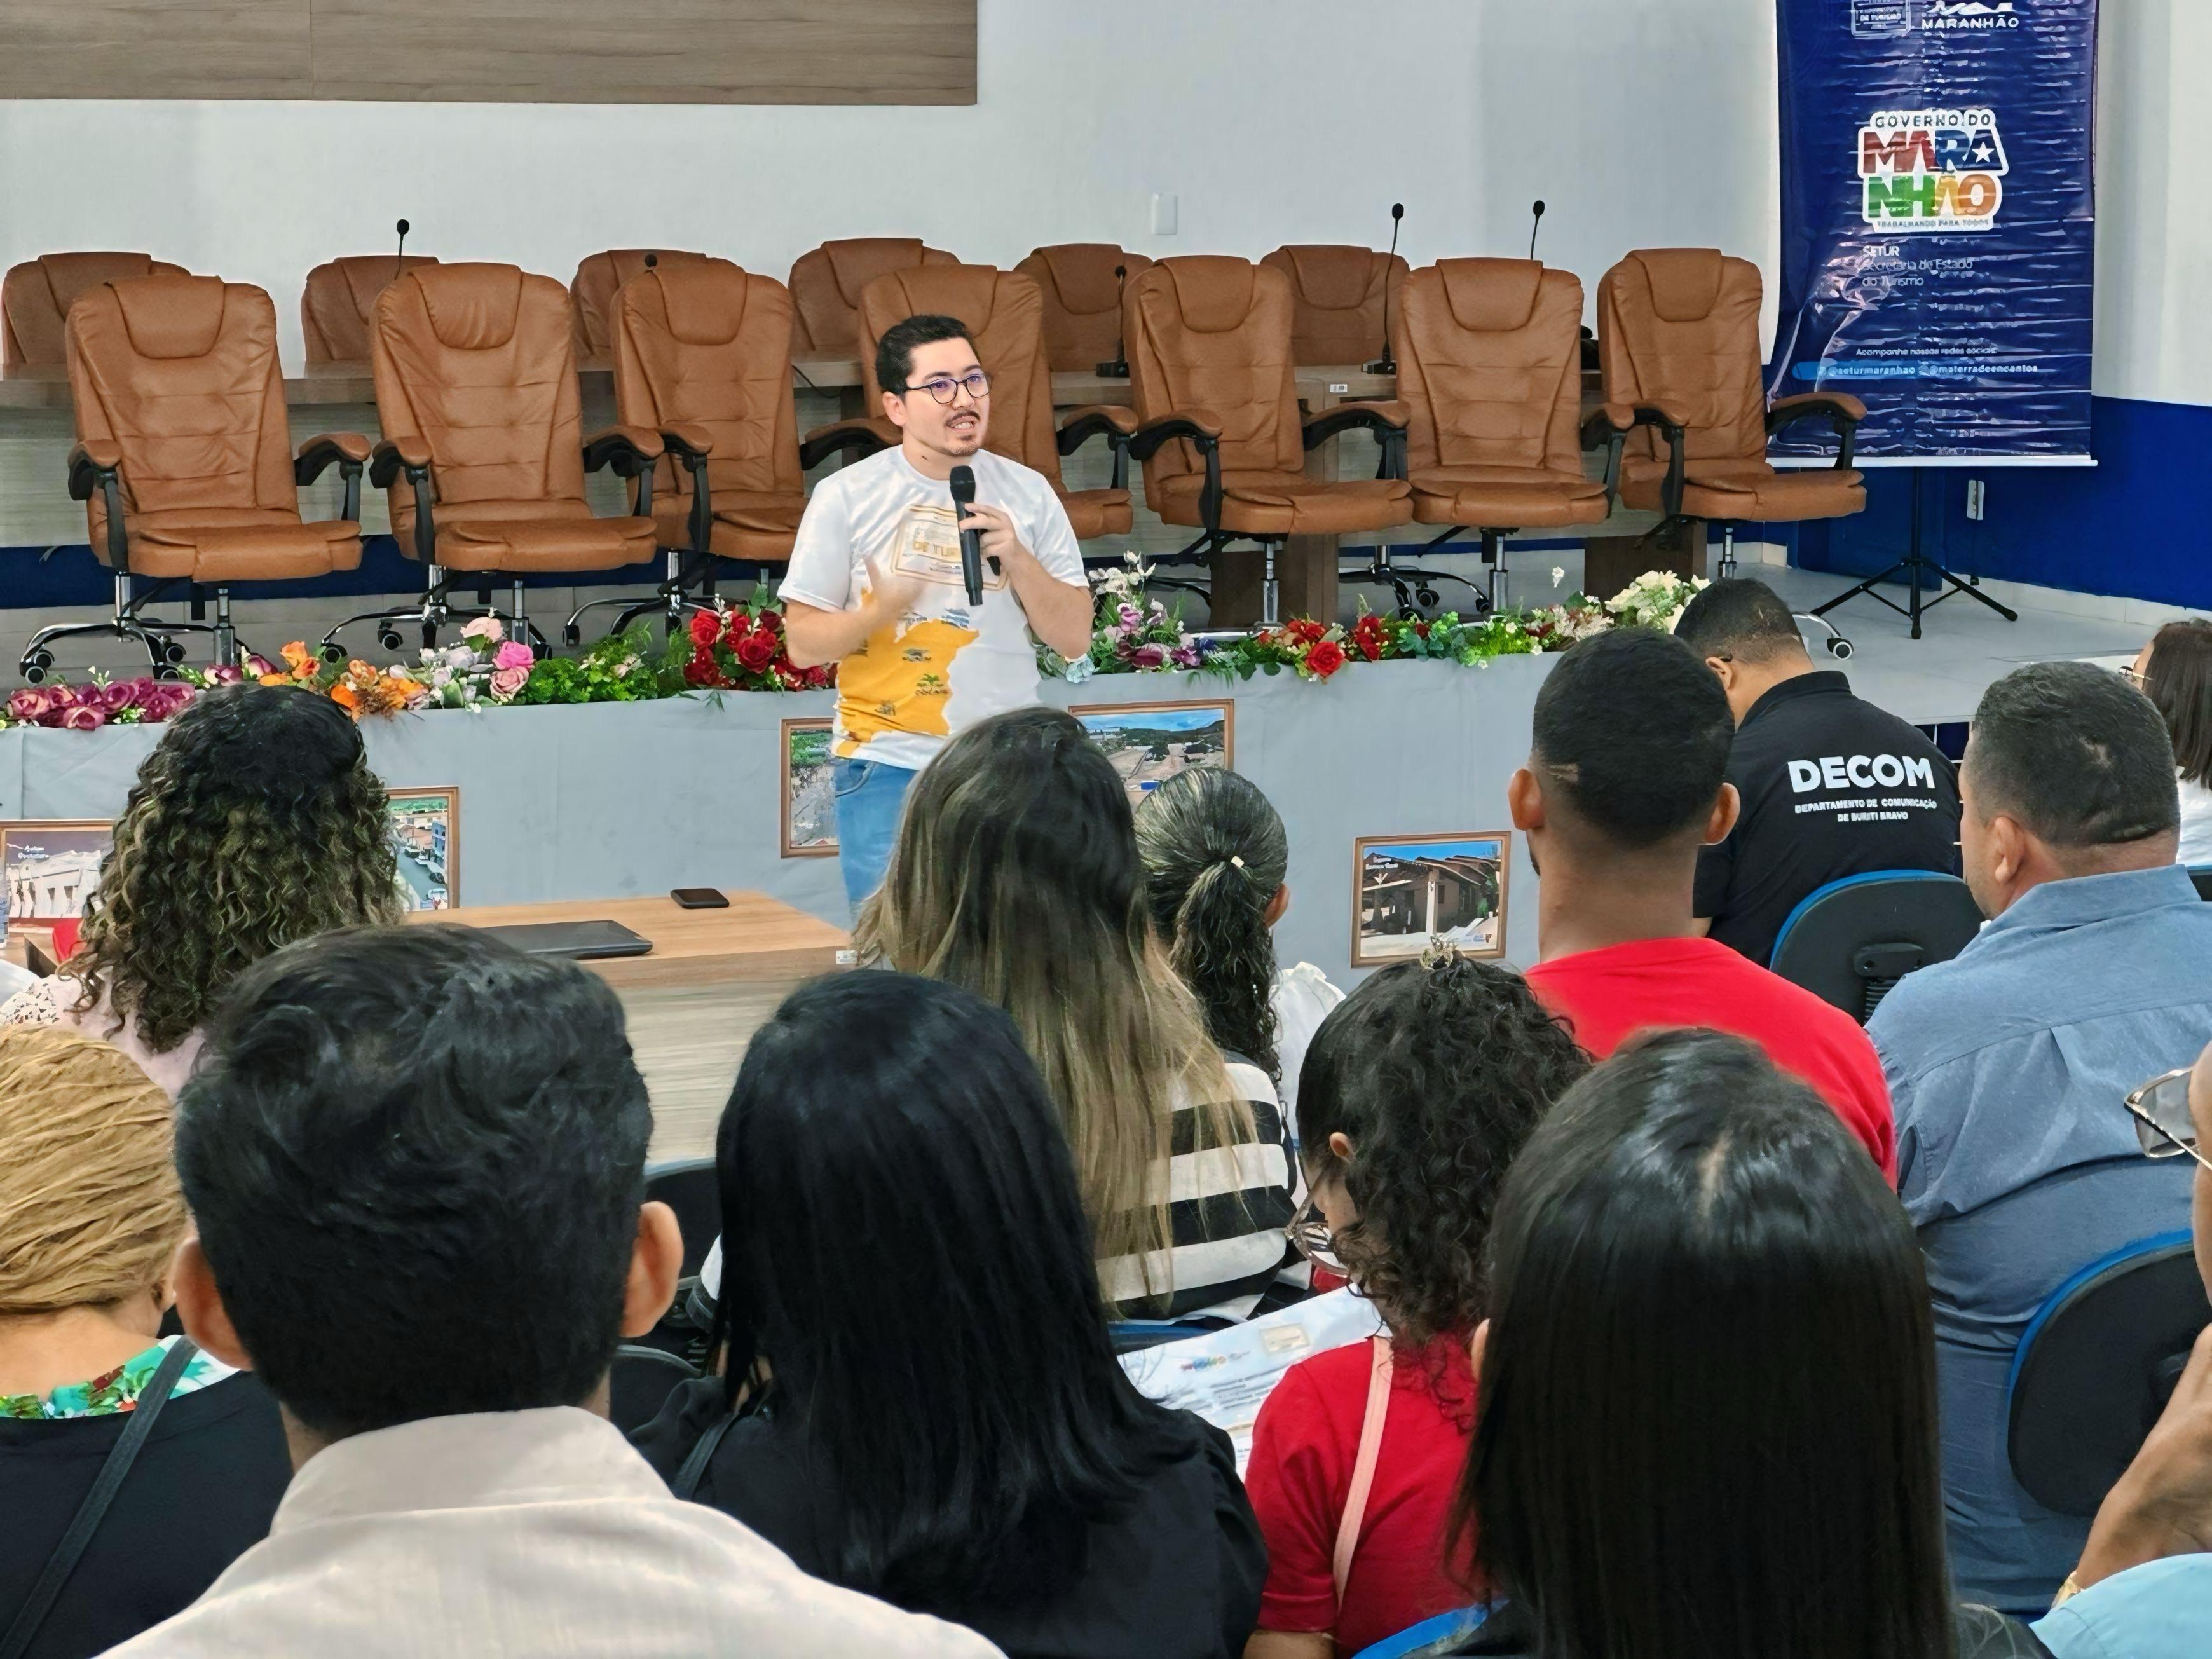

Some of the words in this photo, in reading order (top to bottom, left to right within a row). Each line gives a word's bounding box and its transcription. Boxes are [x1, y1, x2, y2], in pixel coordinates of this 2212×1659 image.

[1922, 14, 2019, 31] MARANHÃO
[1875, 114, 1958, 127] GOVERNO
[1969, 113, 1990, 126] DO
[1863, 129, 2003, 174] MARA
[1862, 245, 1900, 257] SETUR
[1856, 348, 1908, 357] Acompanhe
[1787, 754, 1936, 793] DECOM
[1794, 799, 1865, 814] DEPARTAMENTO
[1867, 798, 1878, 807] DE
[1837, 814, 1849, 822] DE
[1880, 811, 1908, 821] BRAVO
